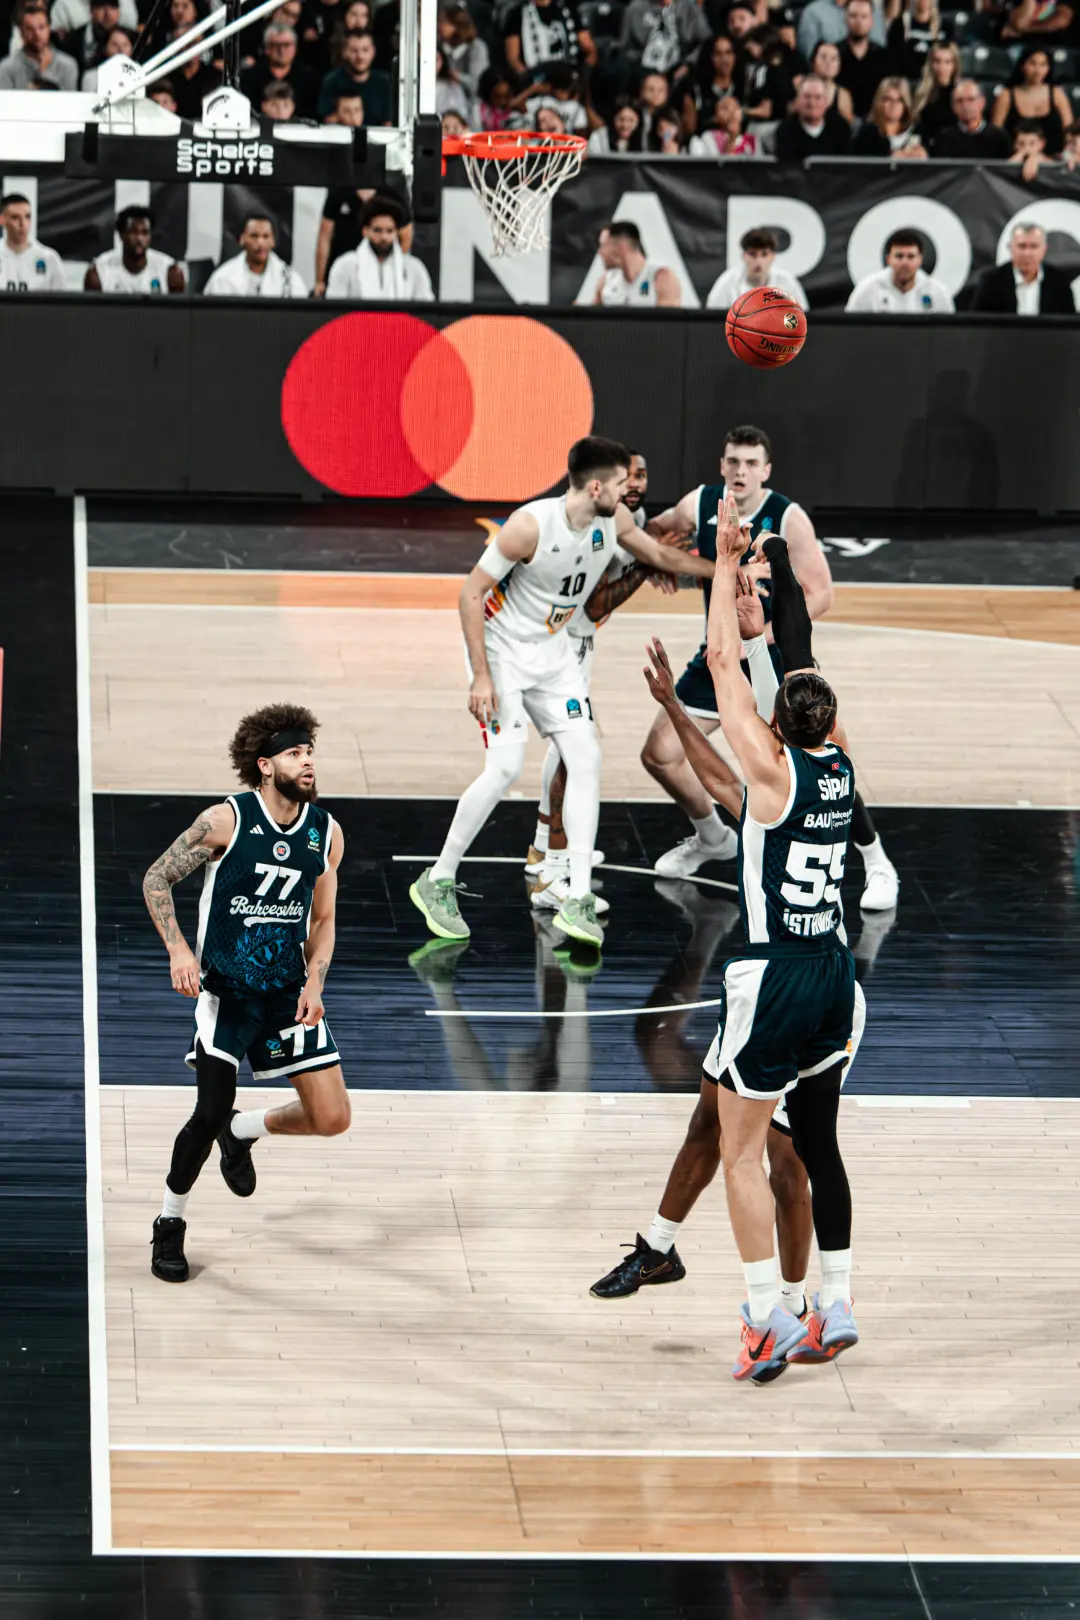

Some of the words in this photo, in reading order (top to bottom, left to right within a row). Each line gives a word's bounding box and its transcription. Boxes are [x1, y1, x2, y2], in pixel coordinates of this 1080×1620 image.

[177, 139, 274, 160] Schelde
[176, 156, 274, 178] Sports
[559, 572, 587, 597] 10
[803, 812, 831, 829] BAU
[254, 862, 303, 901] 77
[780, 840, 848, 908] 55
[278, 1017, 328, 1057] 77
